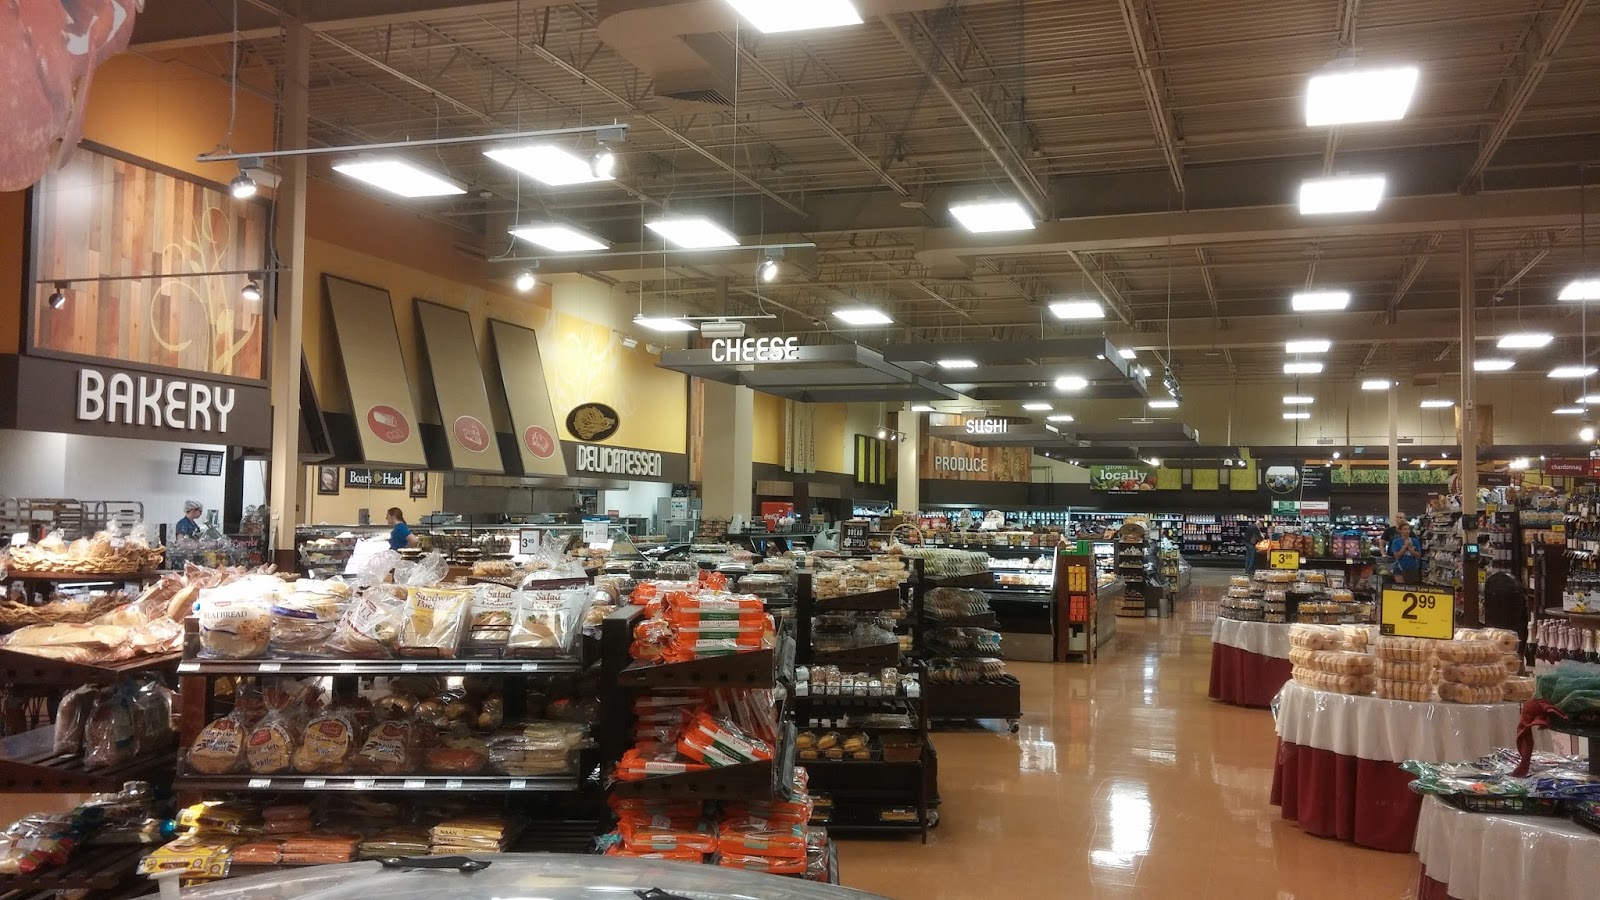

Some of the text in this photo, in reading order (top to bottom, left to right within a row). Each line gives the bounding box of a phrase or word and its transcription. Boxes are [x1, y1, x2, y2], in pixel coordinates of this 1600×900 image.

[711, 337, 799, 362] CHEESE
[77, 368, 235, 433] BAKERY
[965, 418, 1008, 434] SUSHI
[576, 444, 662, 477] DELICATESSEN
[934, 455, 988, 472] PRODUCE
[1551, 464, 1583, 472] chardonnay
[383, 473, 402, 485] Head
[1100, 470, 1148, 483] locally
[487, 590, 512, 599] Salad
[535, 592, 561, 601] Salad
